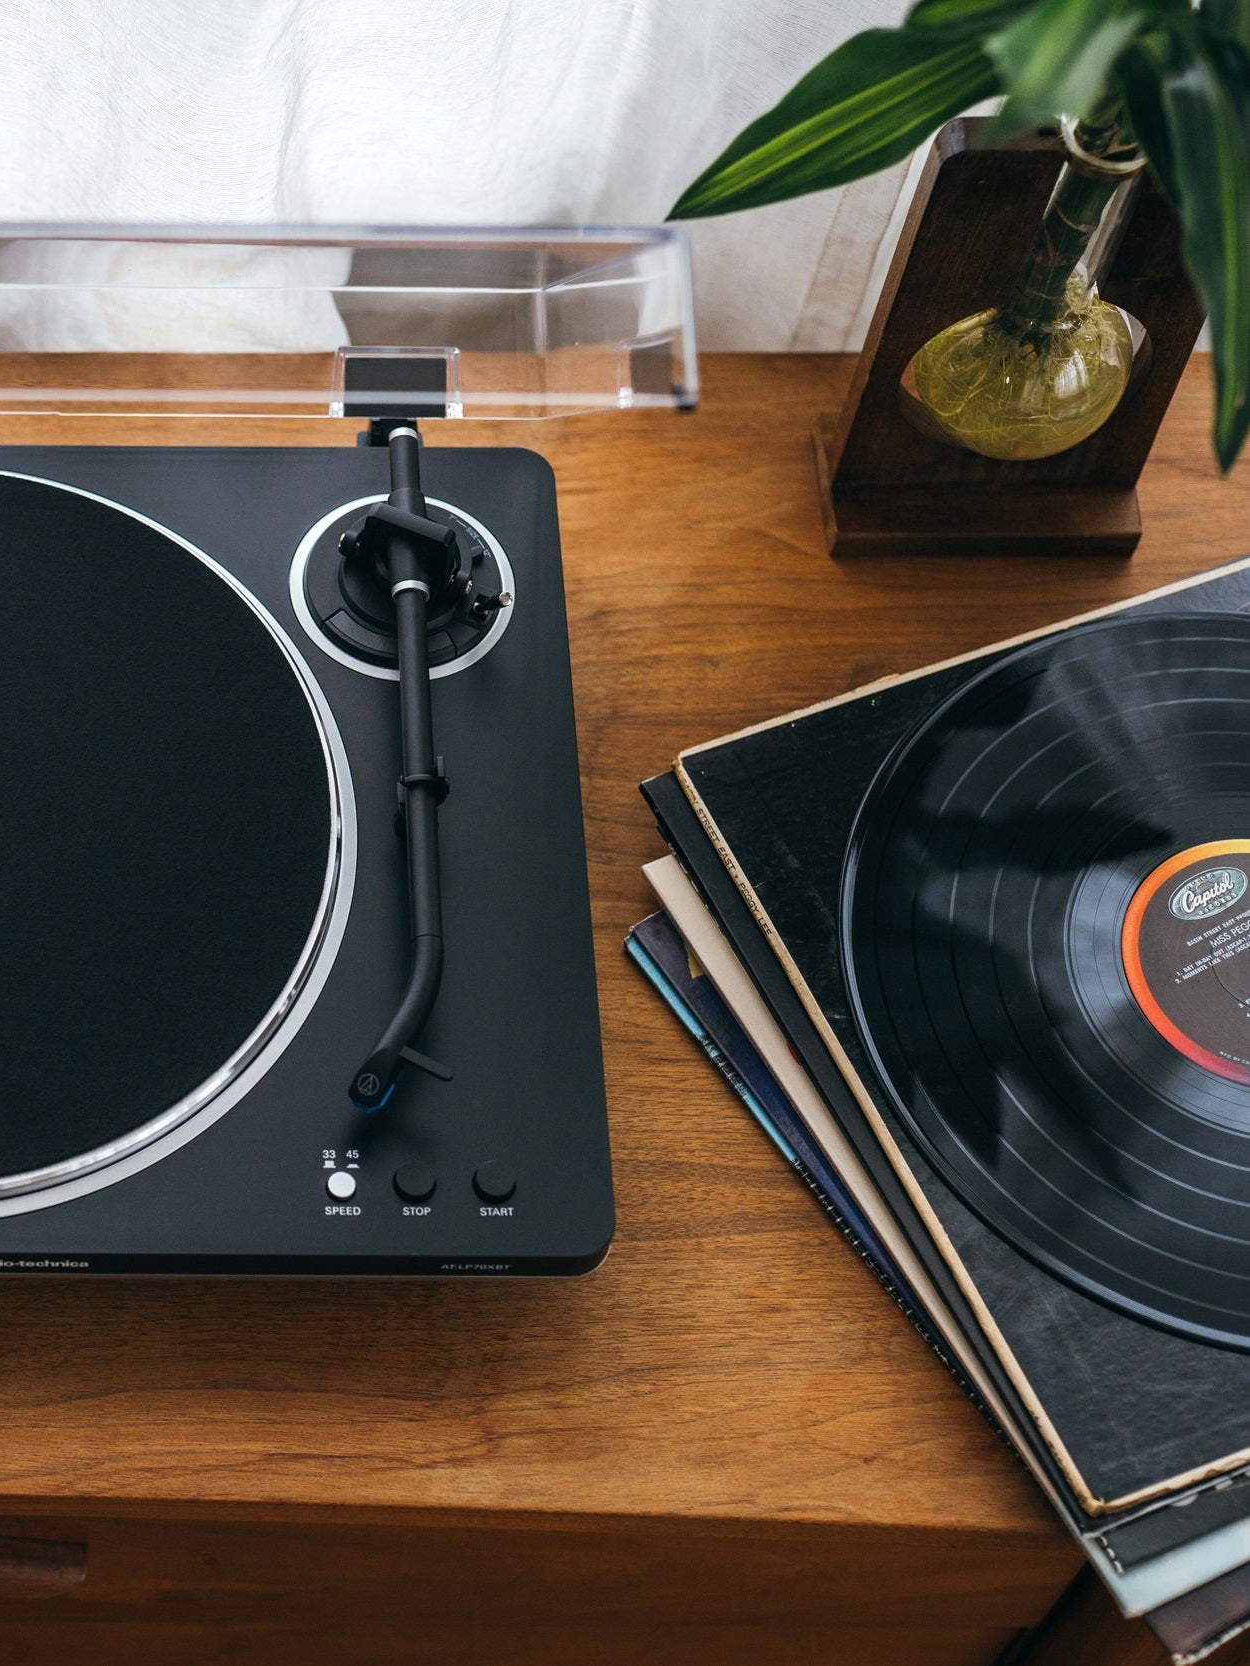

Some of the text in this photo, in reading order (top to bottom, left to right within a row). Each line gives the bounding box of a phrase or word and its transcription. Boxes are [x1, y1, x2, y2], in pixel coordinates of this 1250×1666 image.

[696, 808, 772, 937] STREET EAST PEGGY LEE
[1182, 871, 1235, 914] Capitol
[1209, 932, 1232, 948] MISS
[1182, 963, 1208, 981] MOMENTS
[322, 1150, 360, 1159] 33 45
[324, 1206, 361, 1216] SPEED
[402, 1207, 432, 1217] STOP
[479, 1207, 515, 1217] START
